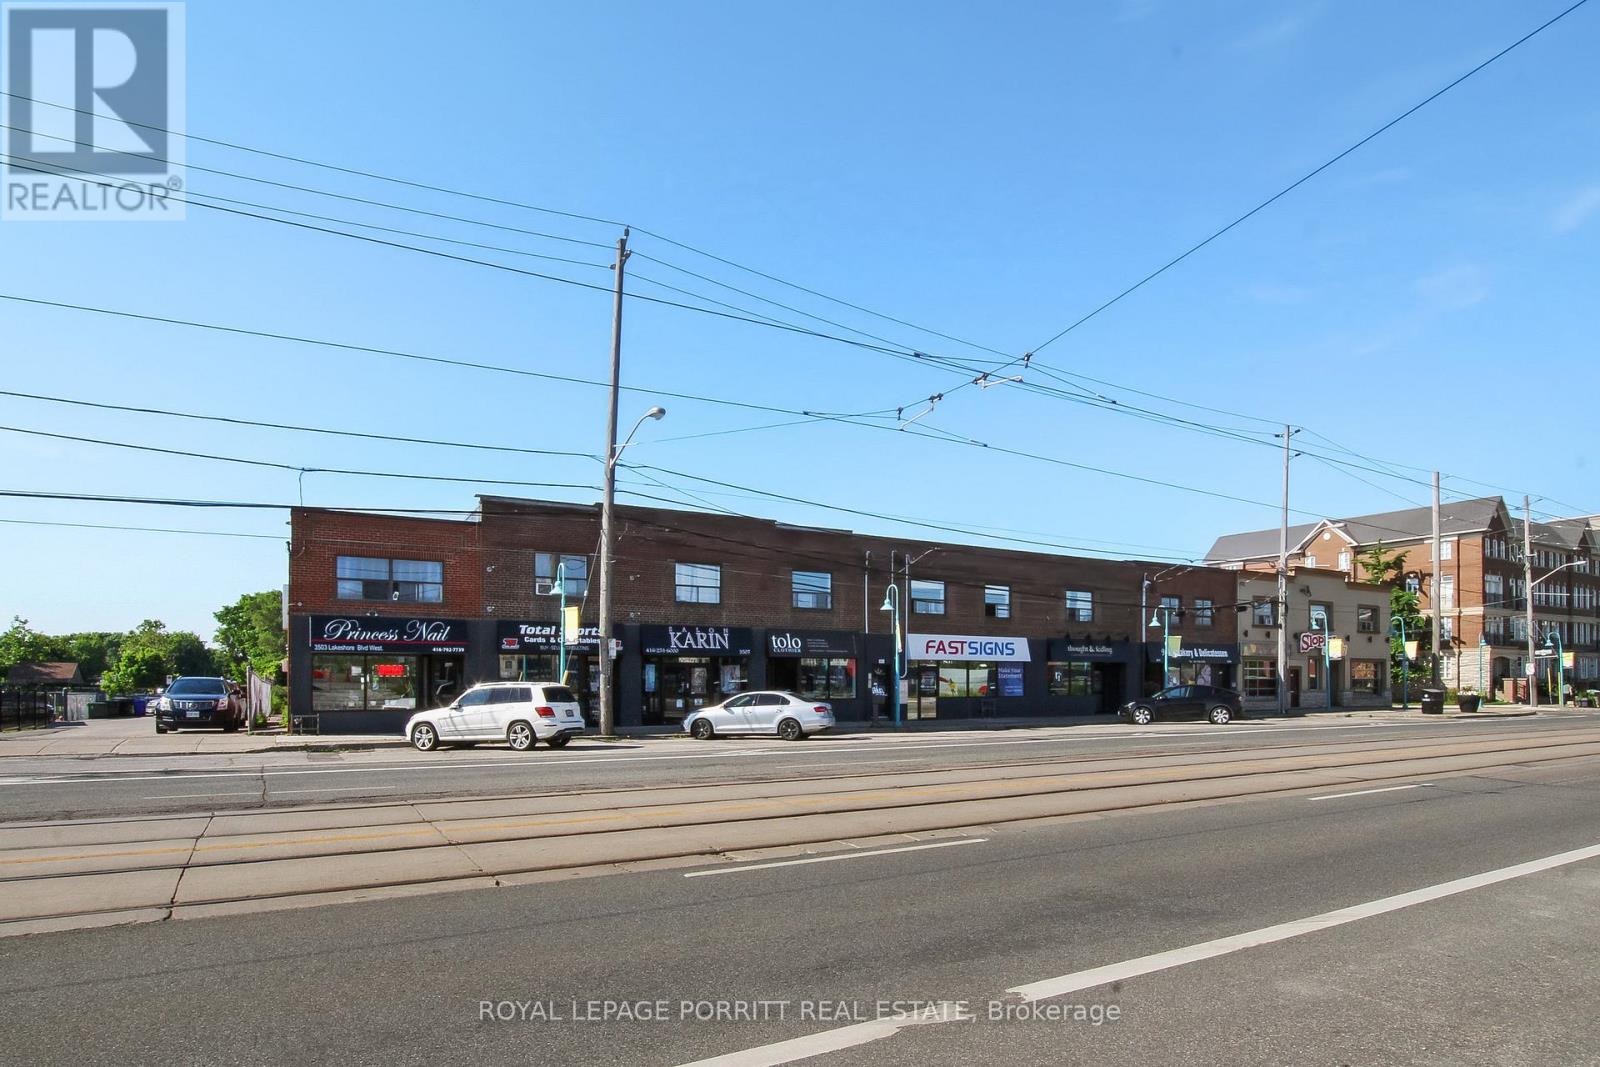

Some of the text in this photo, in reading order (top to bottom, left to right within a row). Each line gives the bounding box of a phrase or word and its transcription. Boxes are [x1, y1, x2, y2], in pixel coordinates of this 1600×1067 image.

[323, 619, 450, 641] Princess Nail
[519, 625, 556, 635] Total
[669, 632, 729, 649] KARIN
[771, 633, 802, 649] tolo
[925, 640, 1015, 656] FASTSIGNS
